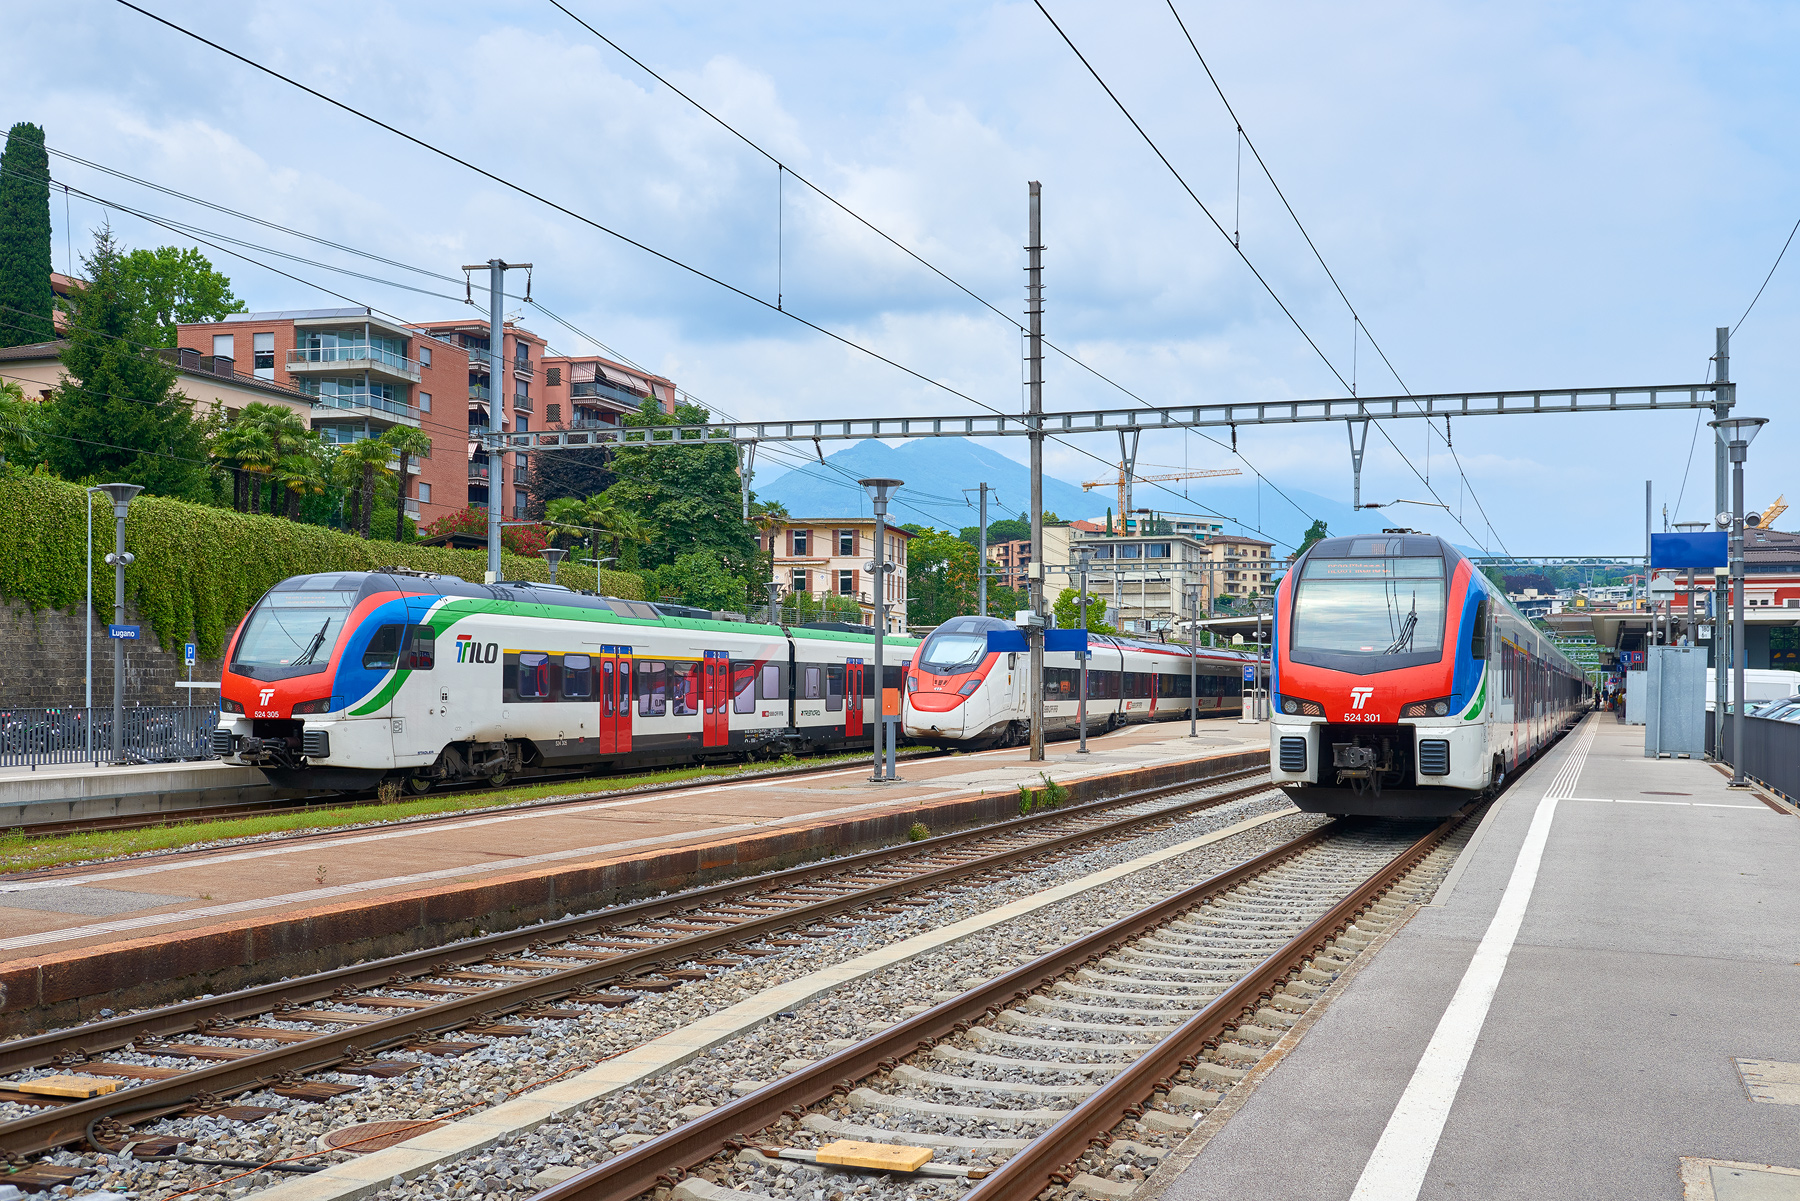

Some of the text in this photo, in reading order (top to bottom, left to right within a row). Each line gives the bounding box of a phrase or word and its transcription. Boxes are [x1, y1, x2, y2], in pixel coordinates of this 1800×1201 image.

[112, 629, 135, 638] Lugano
[188, 646, 193, 657] P
[456, 634, 498, 664] TILO
[1344, 713, 1380, 722] 524 301
